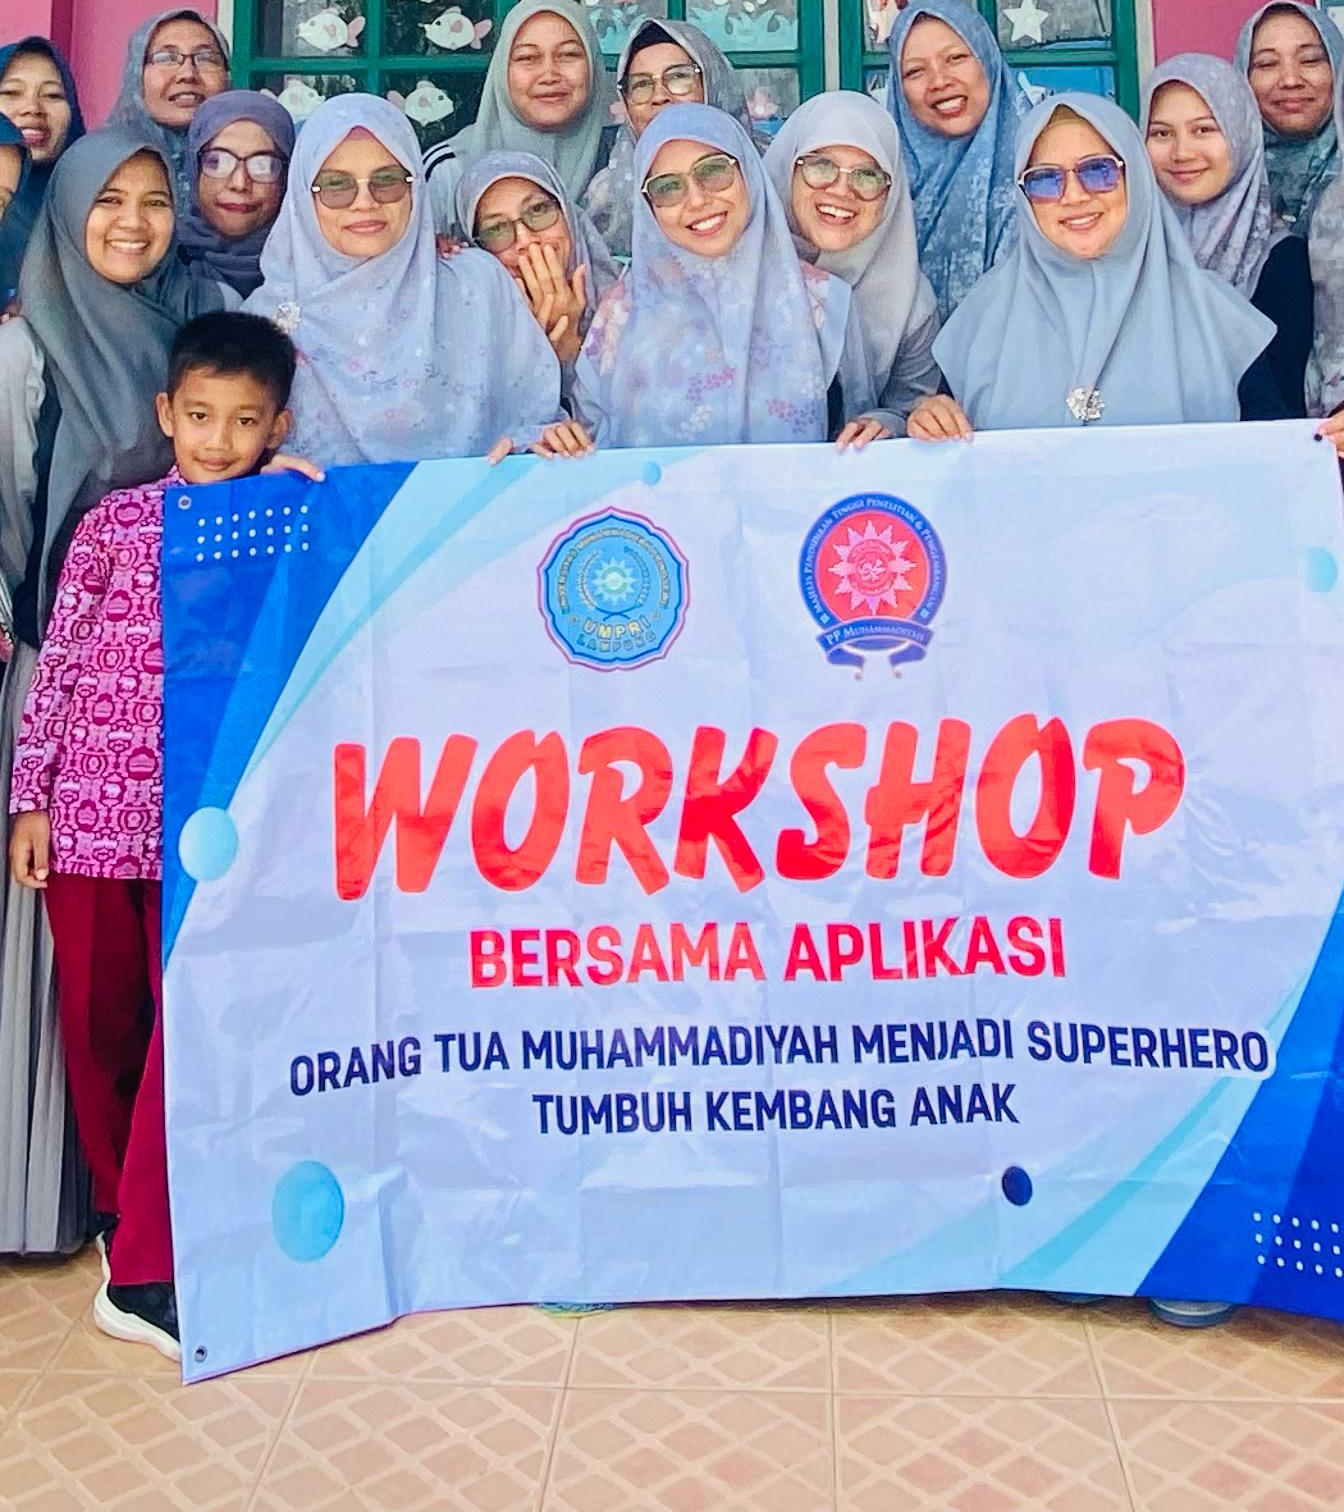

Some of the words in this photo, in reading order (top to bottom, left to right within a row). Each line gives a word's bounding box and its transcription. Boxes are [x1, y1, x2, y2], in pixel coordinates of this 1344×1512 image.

[583, 615, 652, 641] UMPRI
[333, 712, 1186, 902] WORKSHOP
[469, 921, 766, 989] BERSAMA
[783, 915, 1067, 983] APLIKASI
[289, 1035, 422, 1097] ORANG
[432, 1030, 511, 1074] TUA
[520, 1023, 840, 1072] MUHAMMADIYAH
[850, 1017, 1015, 1065] MENJADI
[1026, 1019, 1270, 1073] SUPERHERO
[531, 1090, 693, 1136] TUMBUH
[705, 1087, 898, 1132] KEMBANG
[909, 1081, 1021, 1127] ANAK
